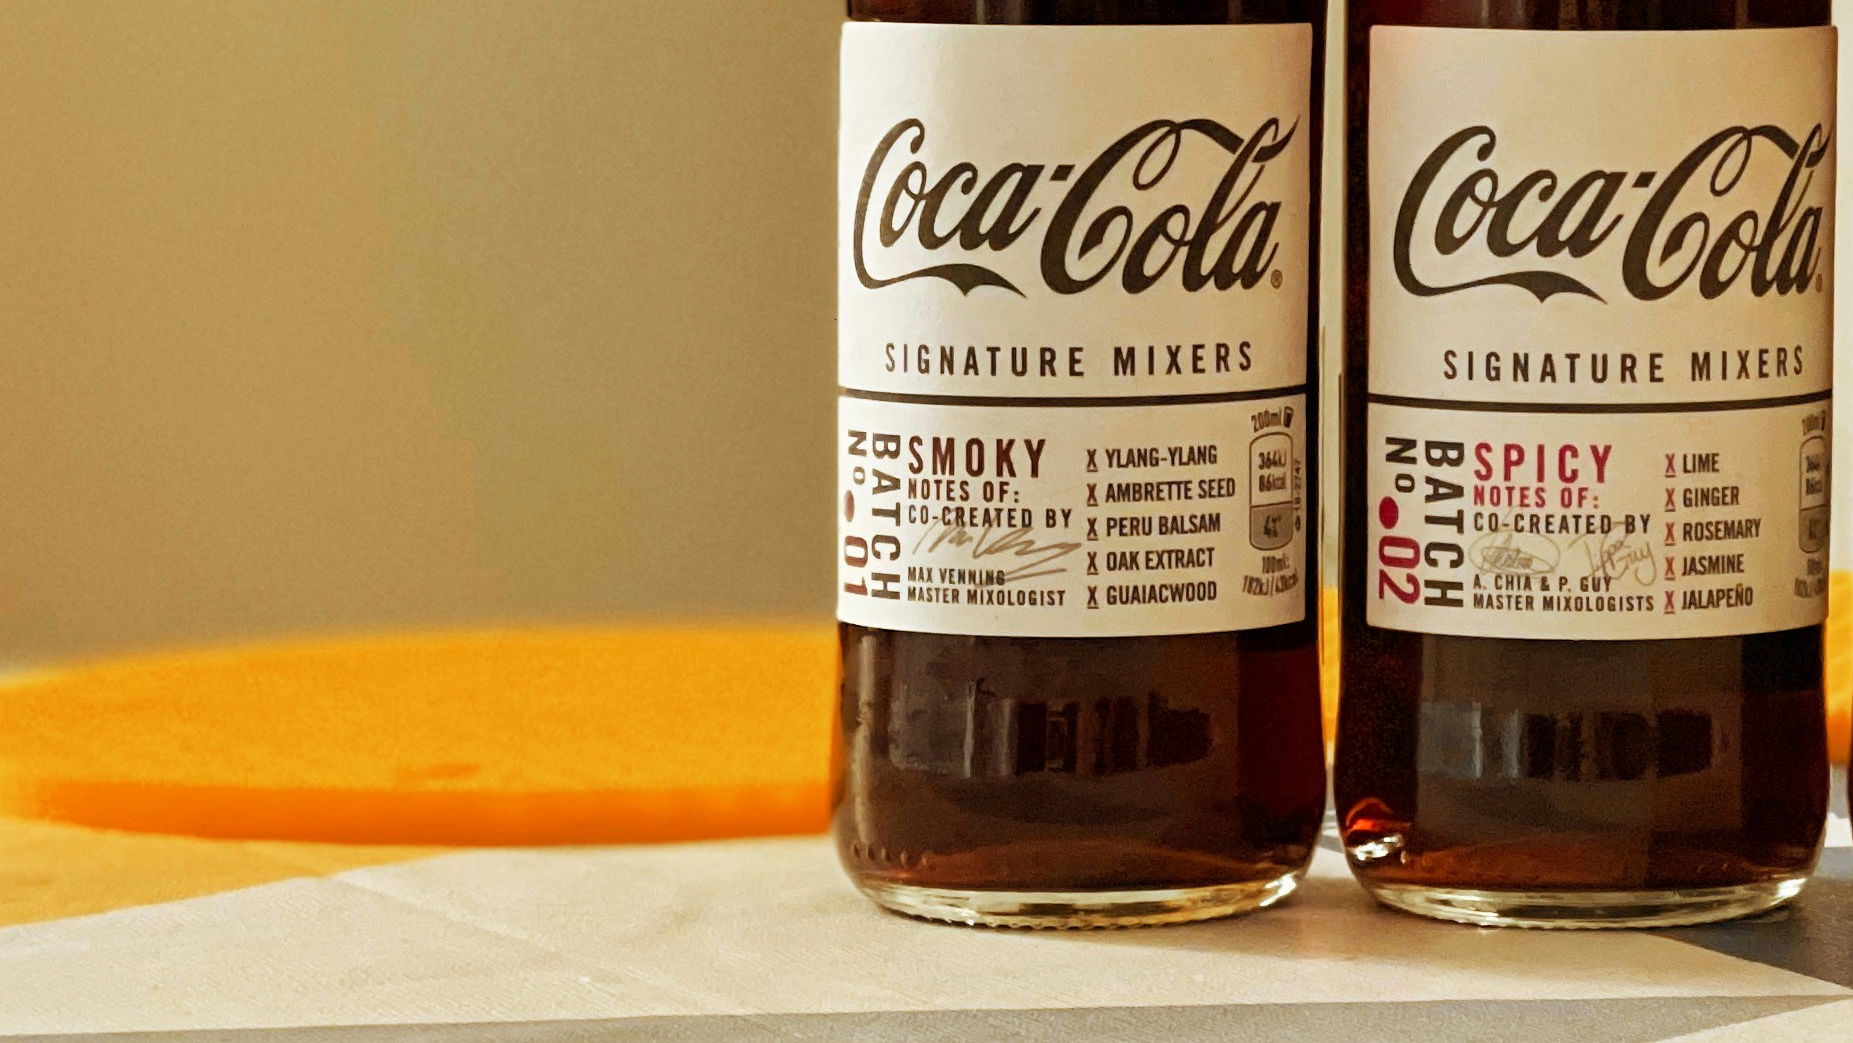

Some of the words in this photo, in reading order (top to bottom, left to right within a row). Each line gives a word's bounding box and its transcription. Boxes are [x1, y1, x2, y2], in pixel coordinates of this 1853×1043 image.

[853, 117, 1299, 298] Coca-Cola
[1392, 123, 1831, 305] Coca-Cola
[885, 343, 1085, 377] SIGNATURE
[1113, 341, 1252, 377] MIXERS
[1444, 350, 1665, 384] SIGNATURE
[1691, 345, 1803, 382] MIXERS
[908, 435, 1046, 478] SMOKY
[1106, 445, 1217, 468] YLANG-YLANG
[1473, 442, 1613, 484] SPICY
[1683, 453, 1720, 473] LIME
[908, 478, 970, 502] NOTES
[983, 480, 1020, 503] OF:
[1105, 480, 1192, 503] AMBRETTE
[1198, 477, 1235, 499] SEED
[1473, 485, 1545, 509] NOTES
[1560, 486, 1599, 509] OF:
[1683, 486, 1740, 508] GINGER
[871, 433, 900, 600] BATCH
[908, 504, 1033, 528] CO-CREATED
[1046, 509, 1072, 528] BY
[1106, 516, 1152, 537] PERU
[1159, 513, 1221, 536] BALSAM
[1424, 440, 1464, 608] BATCH
[1474, 513, 1612, 536] CO-CREATED
[1625, 513, 1651, 535] BY
[1683, 518, 1761, 542] ROSEMARY
[844, 535, 868, 596] 01
[1106, 551, 1139, 571] OAK
[1145, 547, 1215, 570] EXTRACT
[1378, 536, 1421, 604] 02
[1682, 553, 1744, 576] JASMINE
[908, 566, 933, 583] MAX
[939, 568, 1006, 586] VENNING
[1473, 574, 1487, 591] A.
[1494, 575, 1532, 592] CHIA
[1540, 575, 1550, 592] &
[1559, 577, 1572, 593] P.
[1581, 577, 1611, 593] GUY
[908, 587, 960, 604] MASTER
[967, 589, 1066, 606] MIXOLOGIST
[1106, 581, 1217, 605] GUAIACWOOD
[1473, 593, 1534, 611] MASTER
[1543, 594, 1654, 613] MIXOLOGISTS
[1682, 584, 1754, 611] JALAPEÑO
